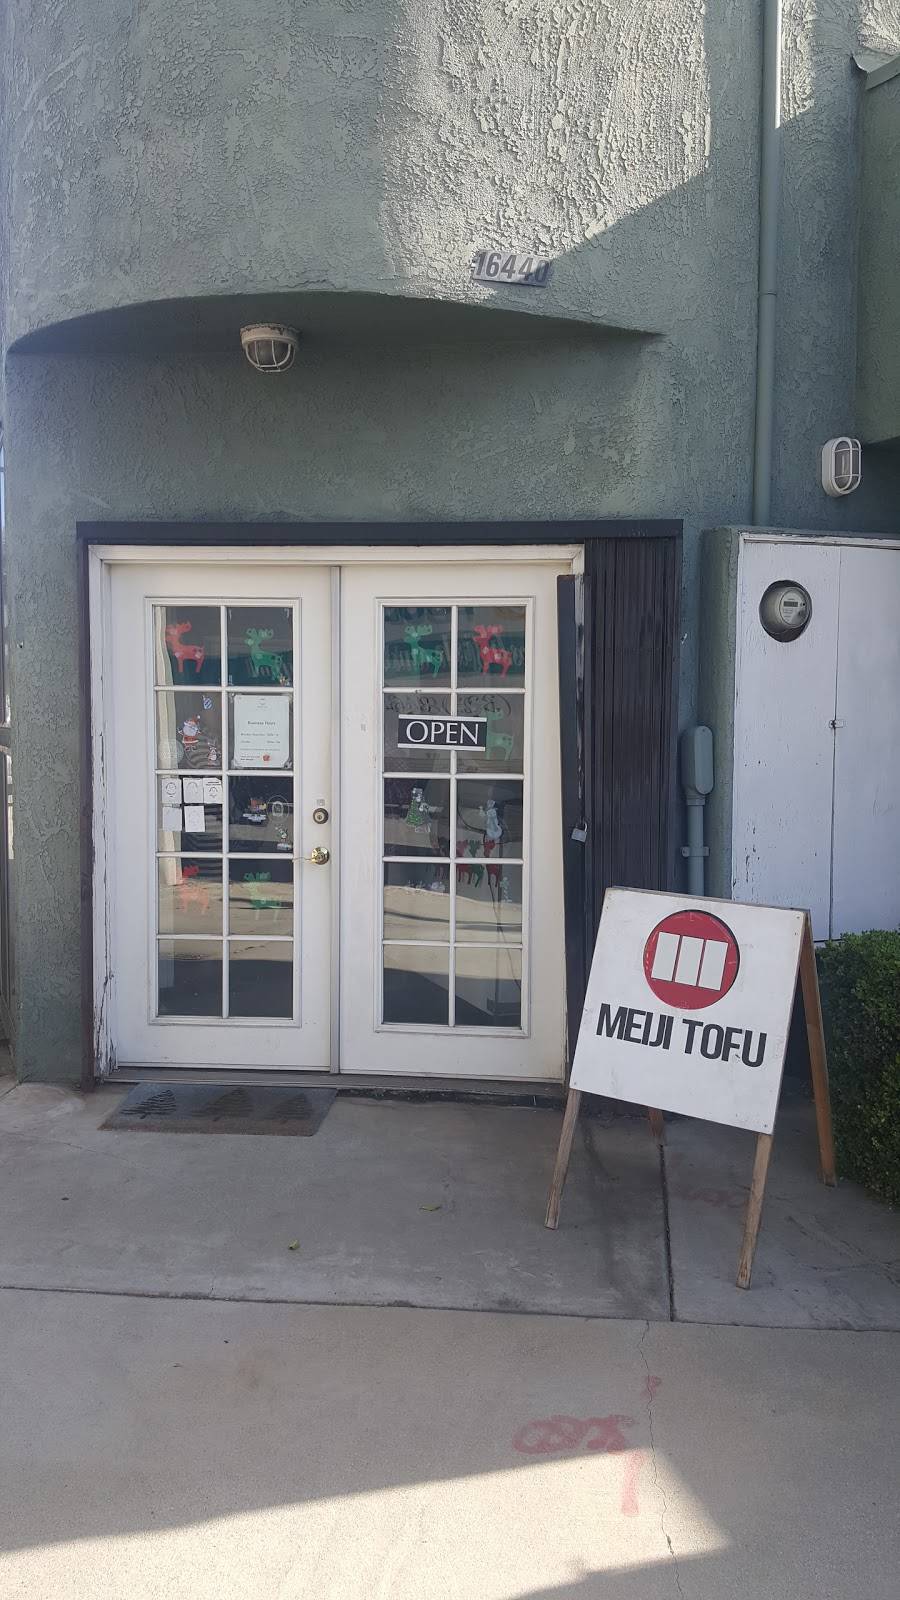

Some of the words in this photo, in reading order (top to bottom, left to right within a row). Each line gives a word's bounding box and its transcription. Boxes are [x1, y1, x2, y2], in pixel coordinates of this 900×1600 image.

[475, 251, 550, 282] 16440
[405, 720, 479, 745] OPEN
[595, 1002, 675, 1051] MEIJI
[682, 1018, 768, 1068] TOFU
